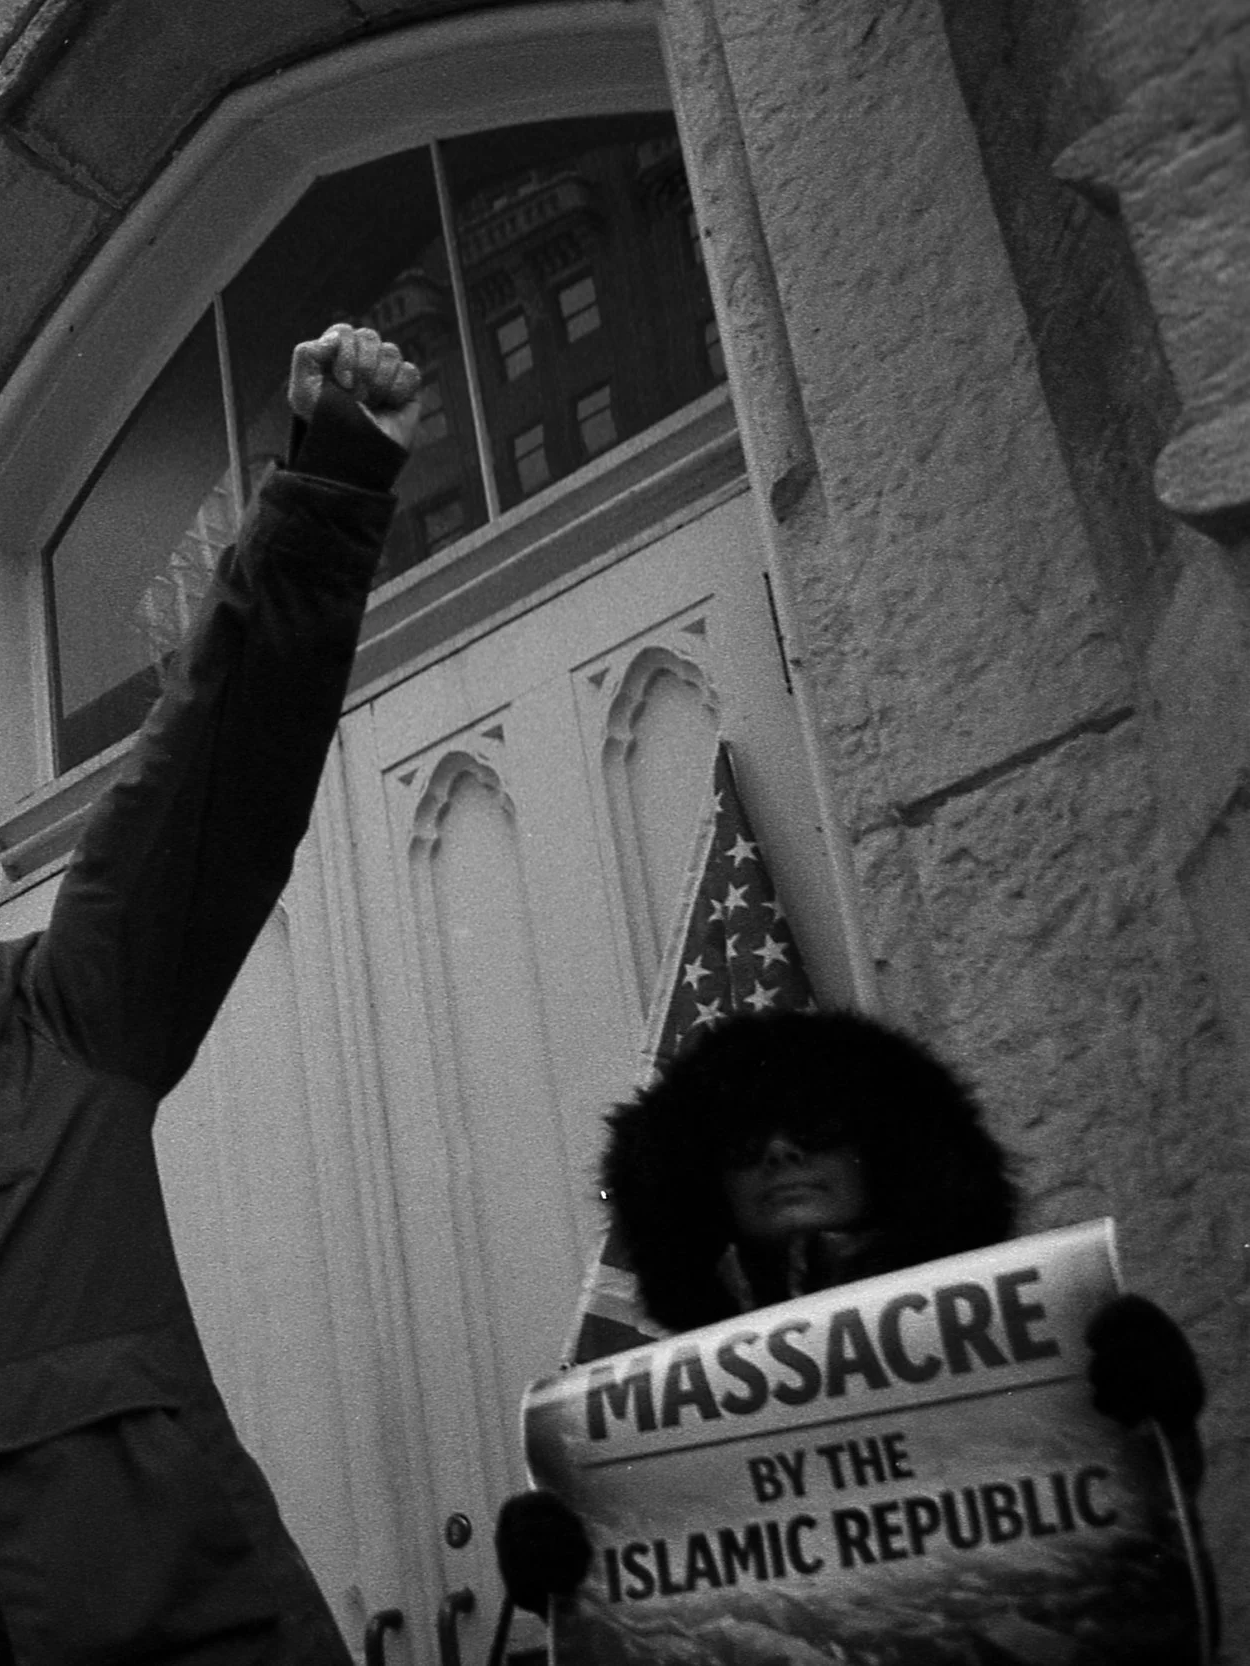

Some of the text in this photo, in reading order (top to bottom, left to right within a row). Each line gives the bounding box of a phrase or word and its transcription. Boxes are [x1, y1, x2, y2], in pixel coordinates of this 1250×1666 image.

[584, 1268, 1060, 1441] MASSACRE
[604, 1466, 1118, 1604] ISLAMIC REPUBLIC
[749, 1432, 914, 1503] BY THE
